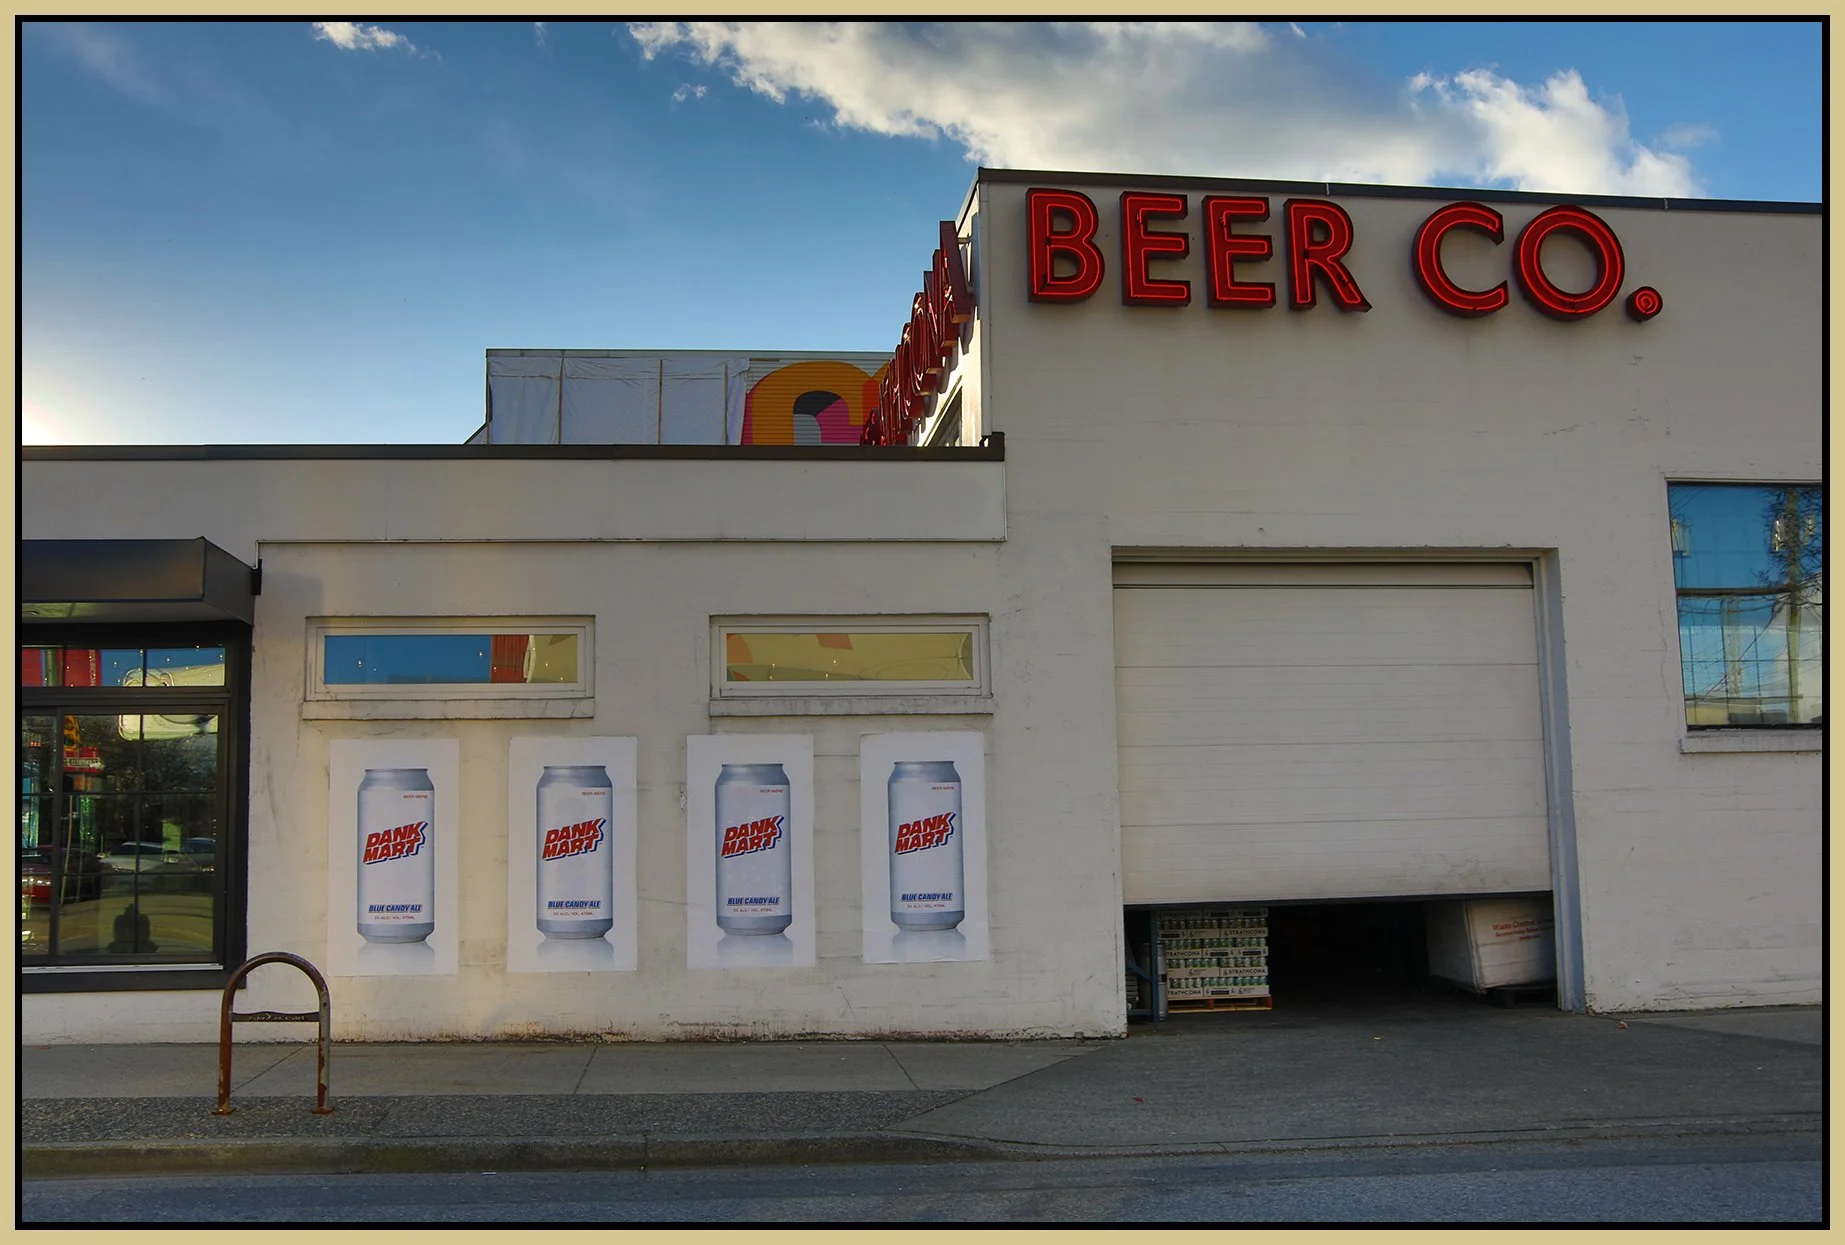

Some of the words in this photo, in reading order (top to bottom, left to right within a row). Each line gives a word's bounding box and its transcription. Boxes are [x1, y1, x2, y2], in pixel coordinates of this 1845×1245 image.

[1025, 188, 1371, 313] BEER
[1412, 201, 1664, 323] CO.
[367, 821, 428, 848] DANK
[546, 818, 606, 844] DANK
[724, 815, 784, 842] DANK
[897, 812, 956, 839] DANK
[363, 836, 423, 865] MART
[542, 832, 600, 861] MART
[721, 830, 779, 859] MART
[895, 827, 950, 856] MART
[369, 904, 386, 912] BLUE
[386, 904, 410, 912] CANDY
[410, 903, 422, 911] ALE
[565, 900, 589, 908] CANDY
[728, 897, 744, 905] BLUE
[768, 896, 780, 904] ALE
[901, 893, 917, 901] BLUE
[941, 892, 953, 900] ALE
